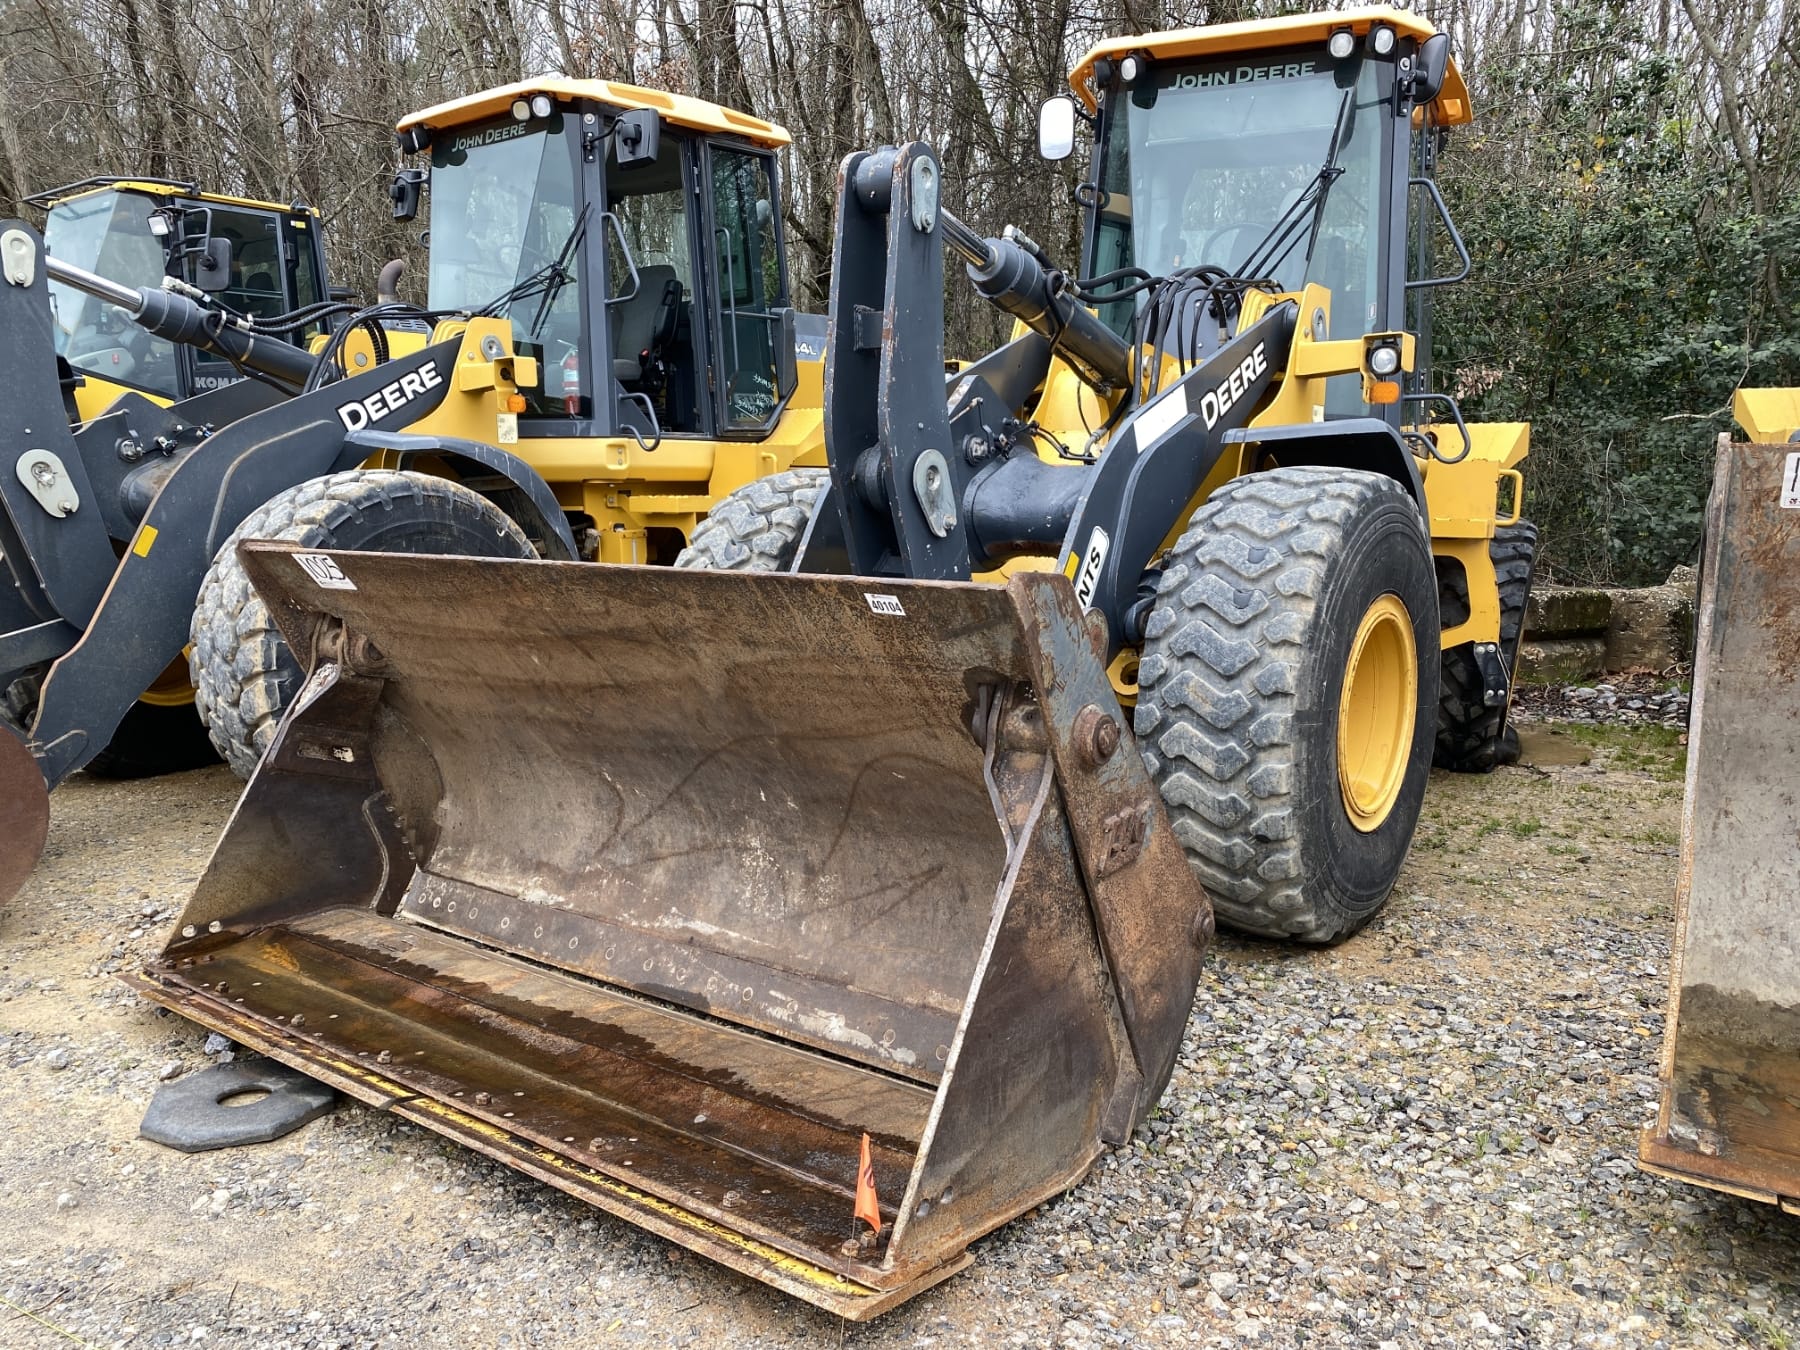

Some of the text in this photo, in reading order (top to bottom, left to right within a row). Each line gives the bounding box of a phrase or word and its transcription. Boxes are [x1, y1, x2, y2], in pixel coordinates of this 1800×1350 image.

[1168, 61, 1315, 91] JOHN DEERE
[451, 122, 526, 152] JOHN DEERE
[337, 360, 443, 432] DEERE
[1200, 341, 1268, 431] DEERE
[871, 600, 903, 612] 40104
